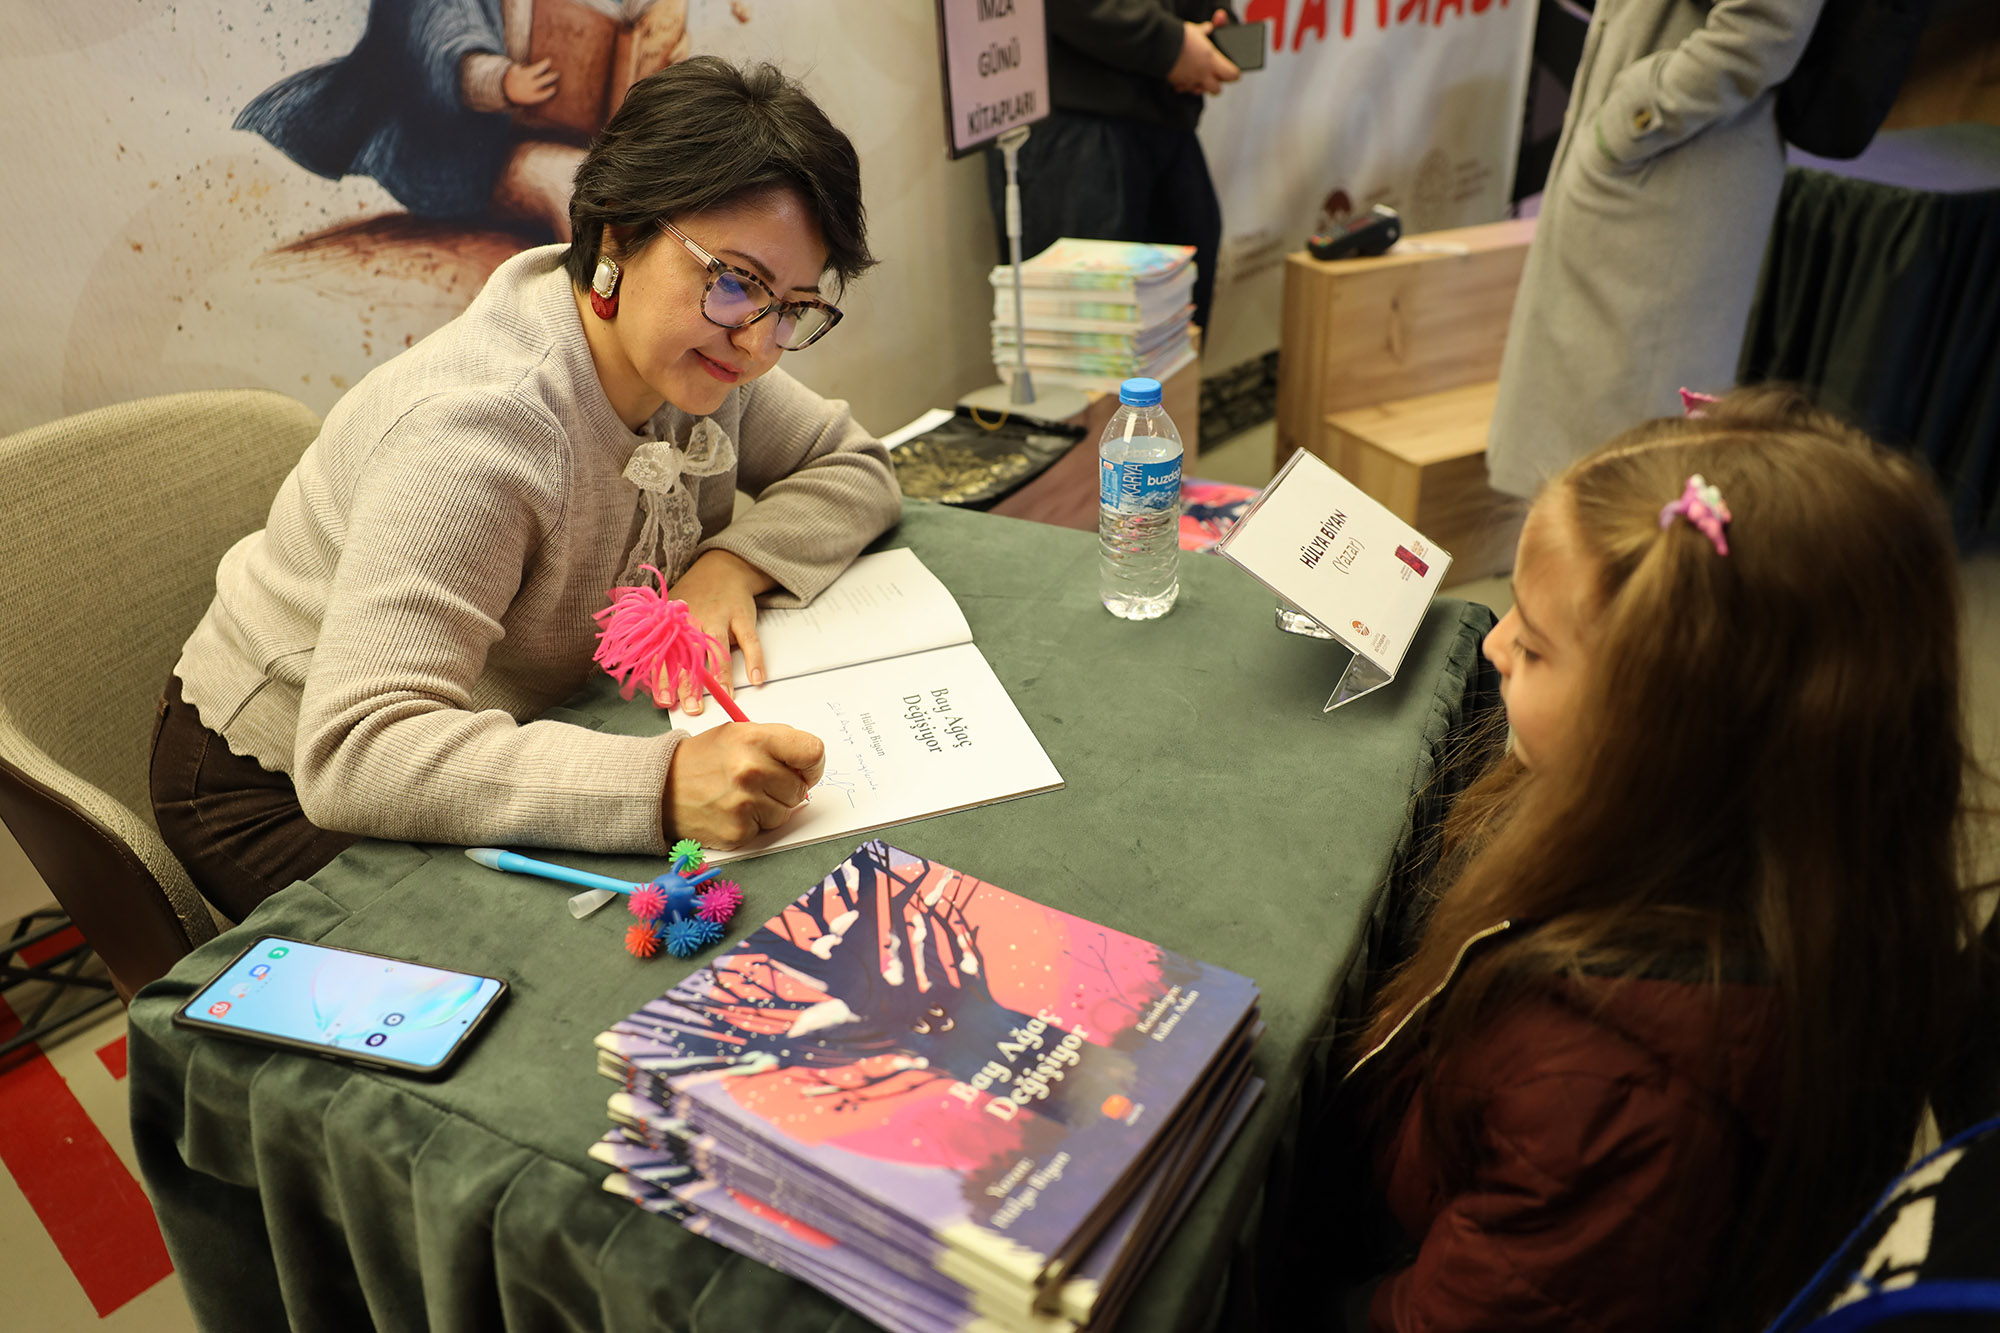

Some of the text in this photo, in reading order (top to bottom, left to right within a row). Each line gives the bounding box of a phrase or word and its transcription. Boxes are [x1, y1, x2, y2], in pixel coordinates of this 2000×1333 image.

[978, 37, 1021, 77] GÜNÜ
[967, 89, 1036, 136] KİTAPLARI
[1299, 508, 1348, 569] HÜLYA BİYAN
[1332, 536, 1365, 575] (Yazar)
[860, 712, 885, 757] Hülya Biyan
[903, 694, 942, 752] Değişiyor
[931, 687, 972, 748] Bay Ağaç
[948, 1008, 1063, 1105] Bay Ağaç
[984, 1023, 1089, 1122] Değişiyor
